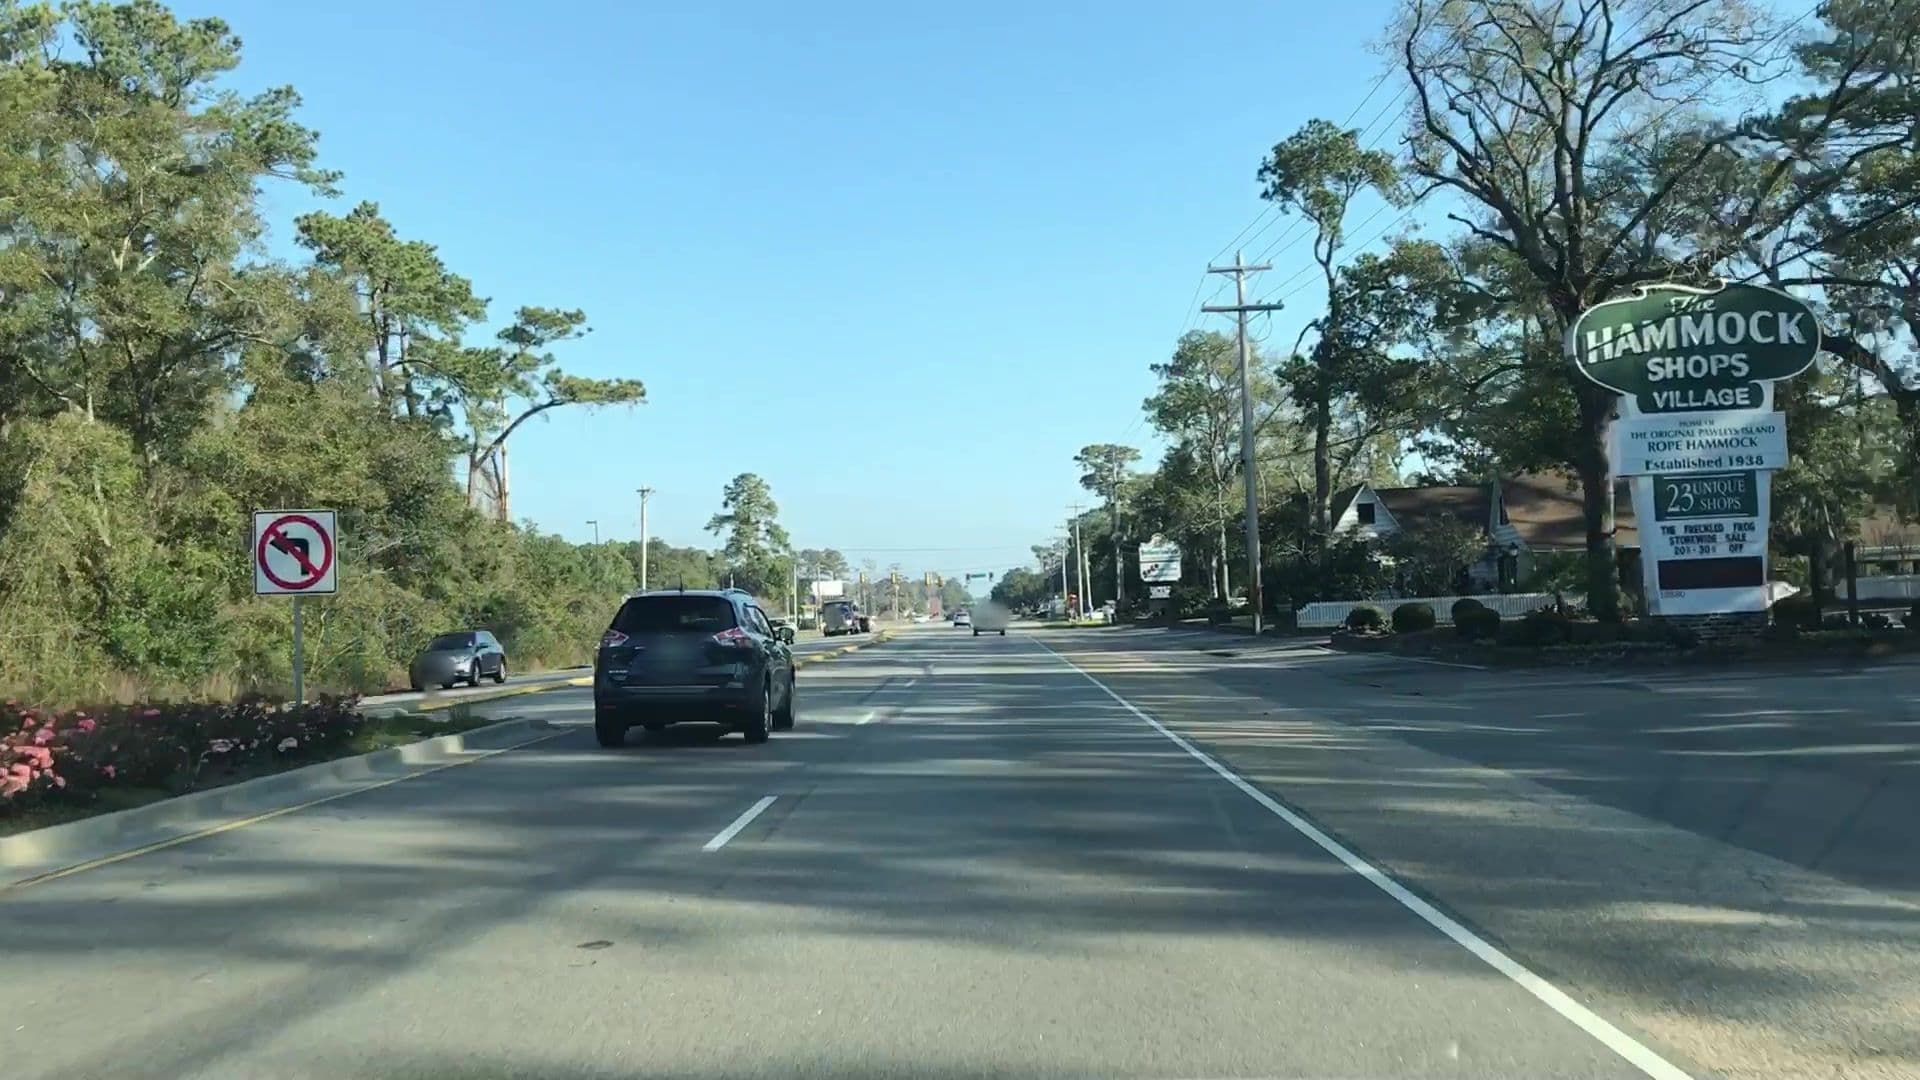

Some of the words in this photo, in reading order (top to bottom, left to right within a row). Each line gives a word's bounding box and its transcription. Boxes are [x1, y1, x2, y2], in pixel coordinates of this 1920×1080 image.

[1668, 295, 1717, 312] The
[1586, 311, 1806, 364] HAMMOCK
[1647, 353, 1750, 382] SHOPS
[1653, 387, 1750, 408] VILLAGE
[1631, 431, 1648, 439] THE
[1650, 429, 1695, 439] ORIGINAL
[1741, 425, 1775, 435] ISLAND
[1648, 440, 1683, 452] ROPE
[1686, 437, 1758, 450] HAMMOCK
[1645, 456, 1722, 471] Established
[1728, 455, 1764, 467] 1938
[1666, 483, 1694, 512] 23
[1693, 479, 1745, 495] UNIQUE
[1700, 498, 1741, 511] SHOPS
[1661, 526, 1675, 535] THE
[1733, 522, 1755, 532] FROG
[1725, 533, 1746, 542] SALE
[1729, 544, 1743, 553] OFF
